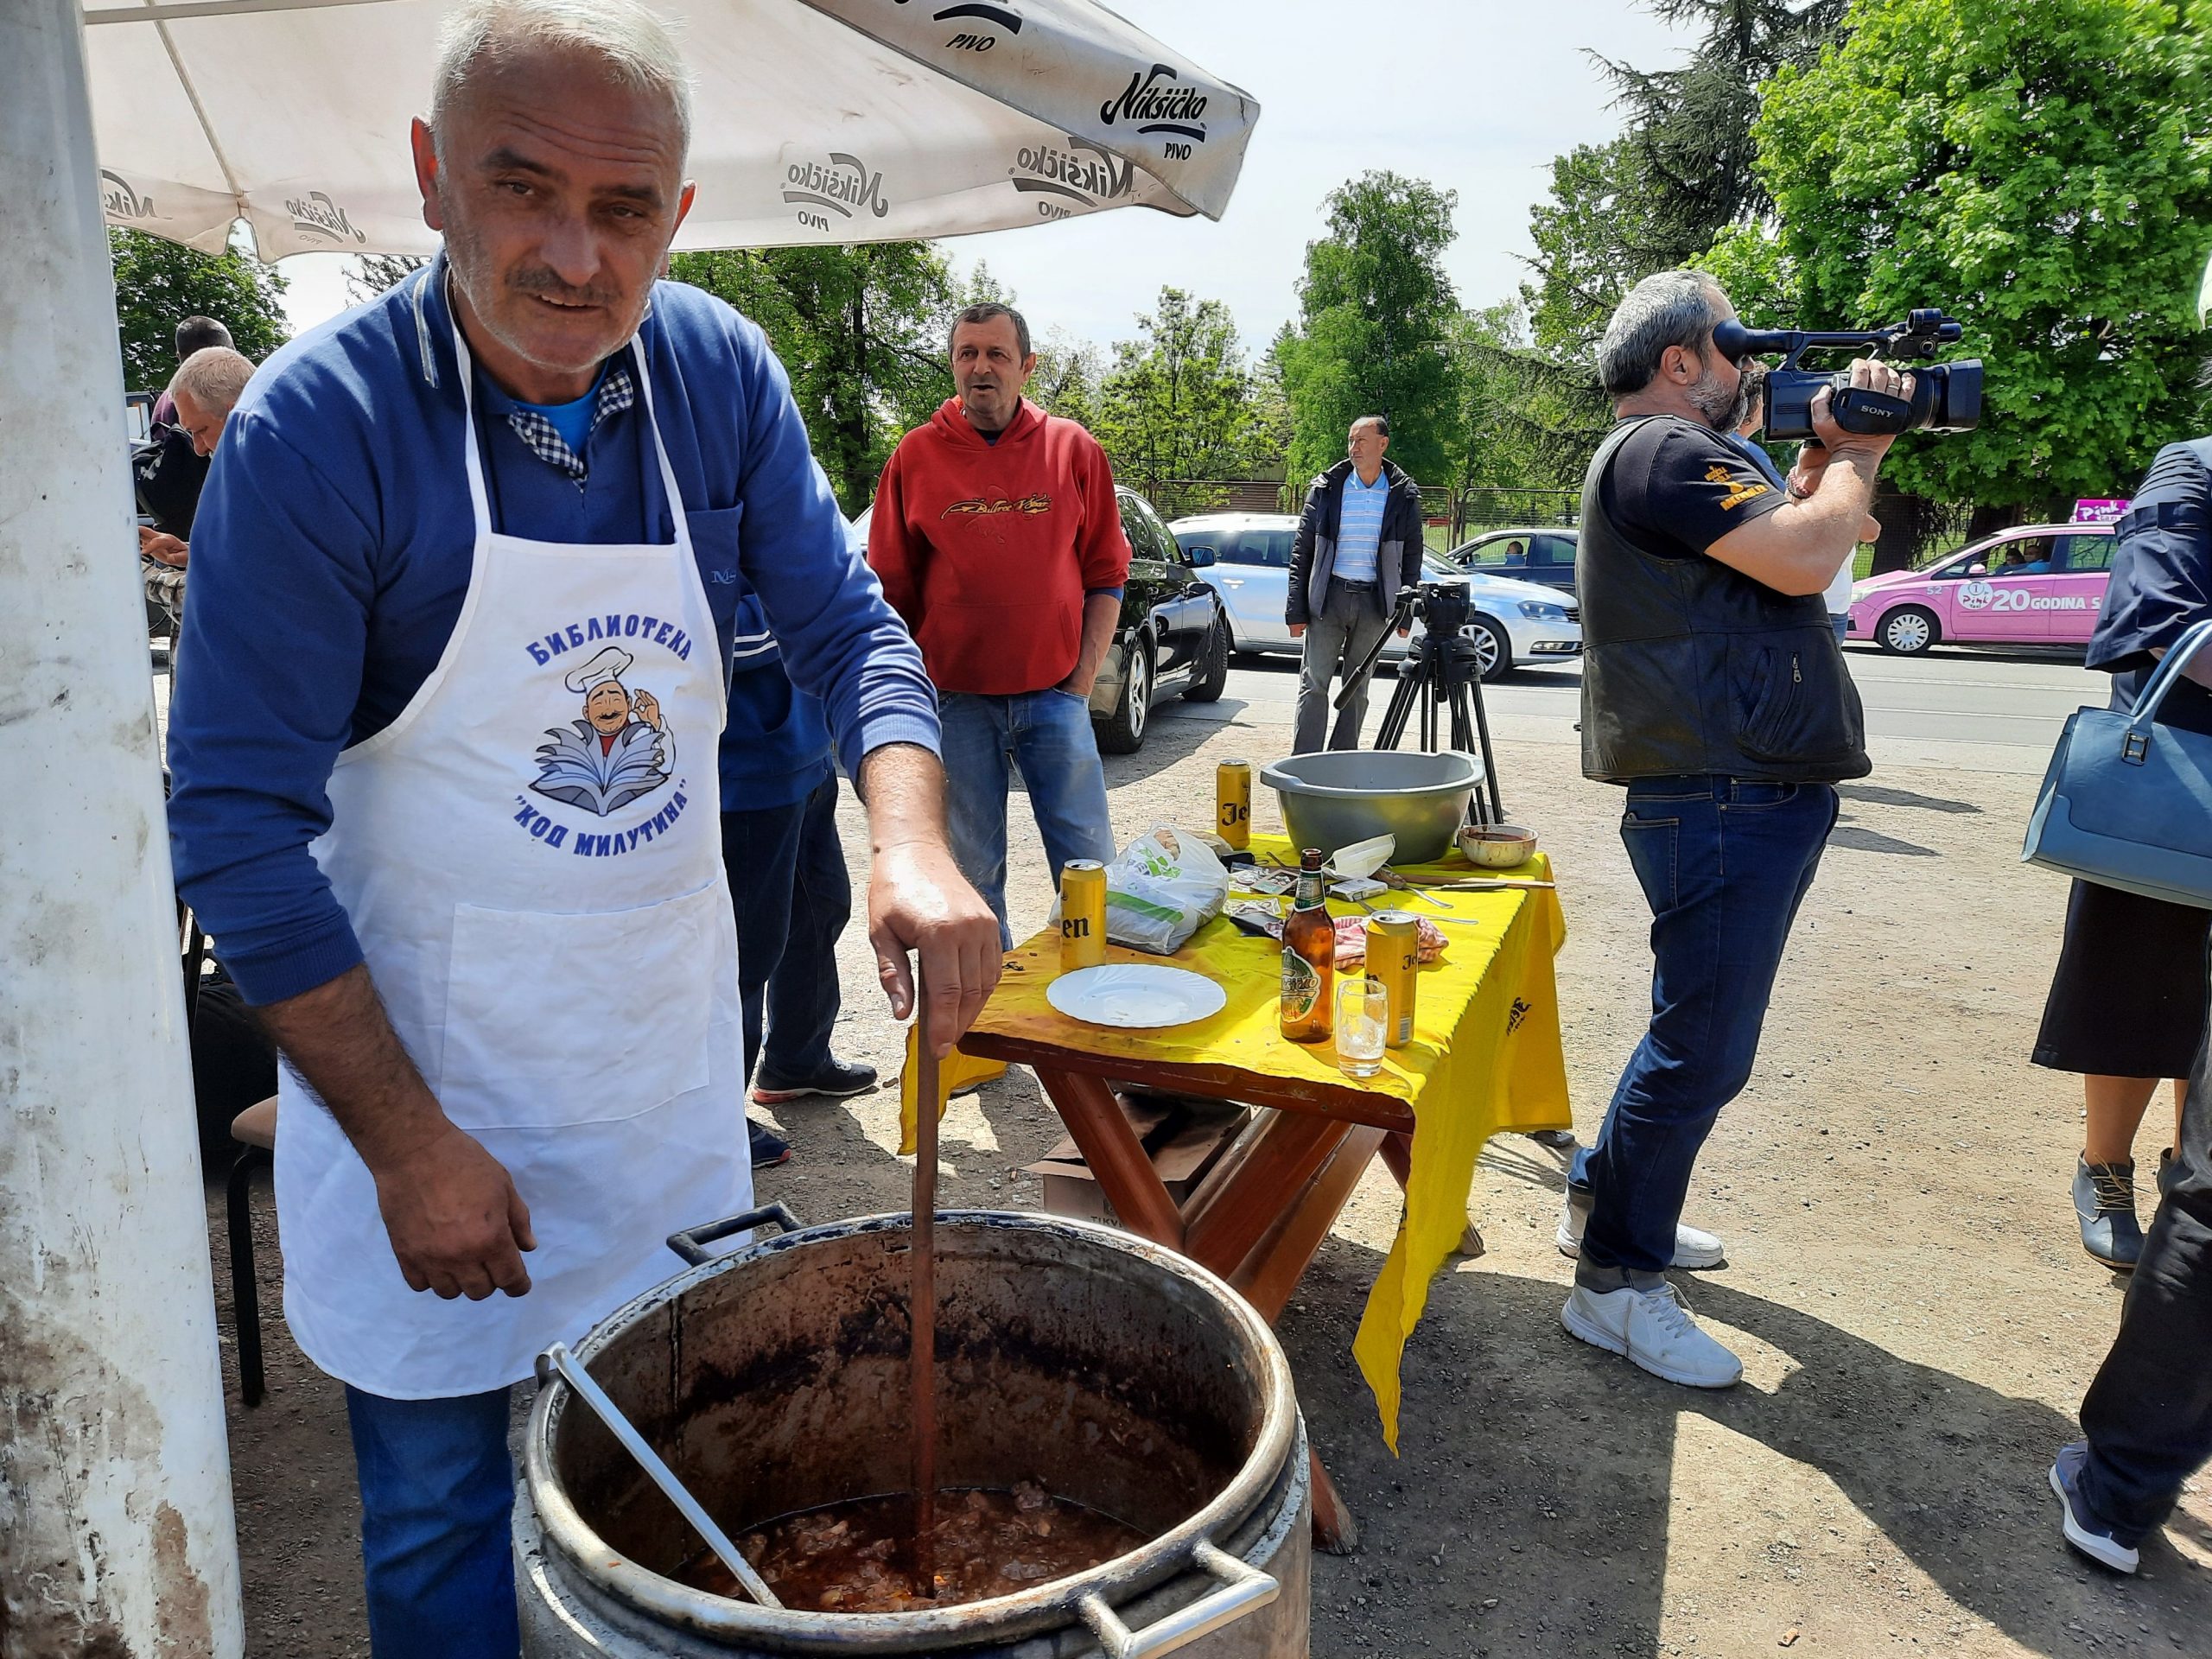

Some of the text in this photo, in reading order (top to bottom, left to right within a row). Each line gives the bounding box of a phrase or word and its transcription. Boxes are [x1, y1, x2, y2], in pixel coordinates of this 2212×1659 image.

[945, 34, 995, 52] PIVO
[1164, 143, 1192, 162] PIVO
[1860, 405, 1894, 417] SONY
[1992, 588, 2031, 612] 20
[2031, 597, 2087, 610] GODINA
[525, 614, 692, 666] БИБЛИОТЕКА
